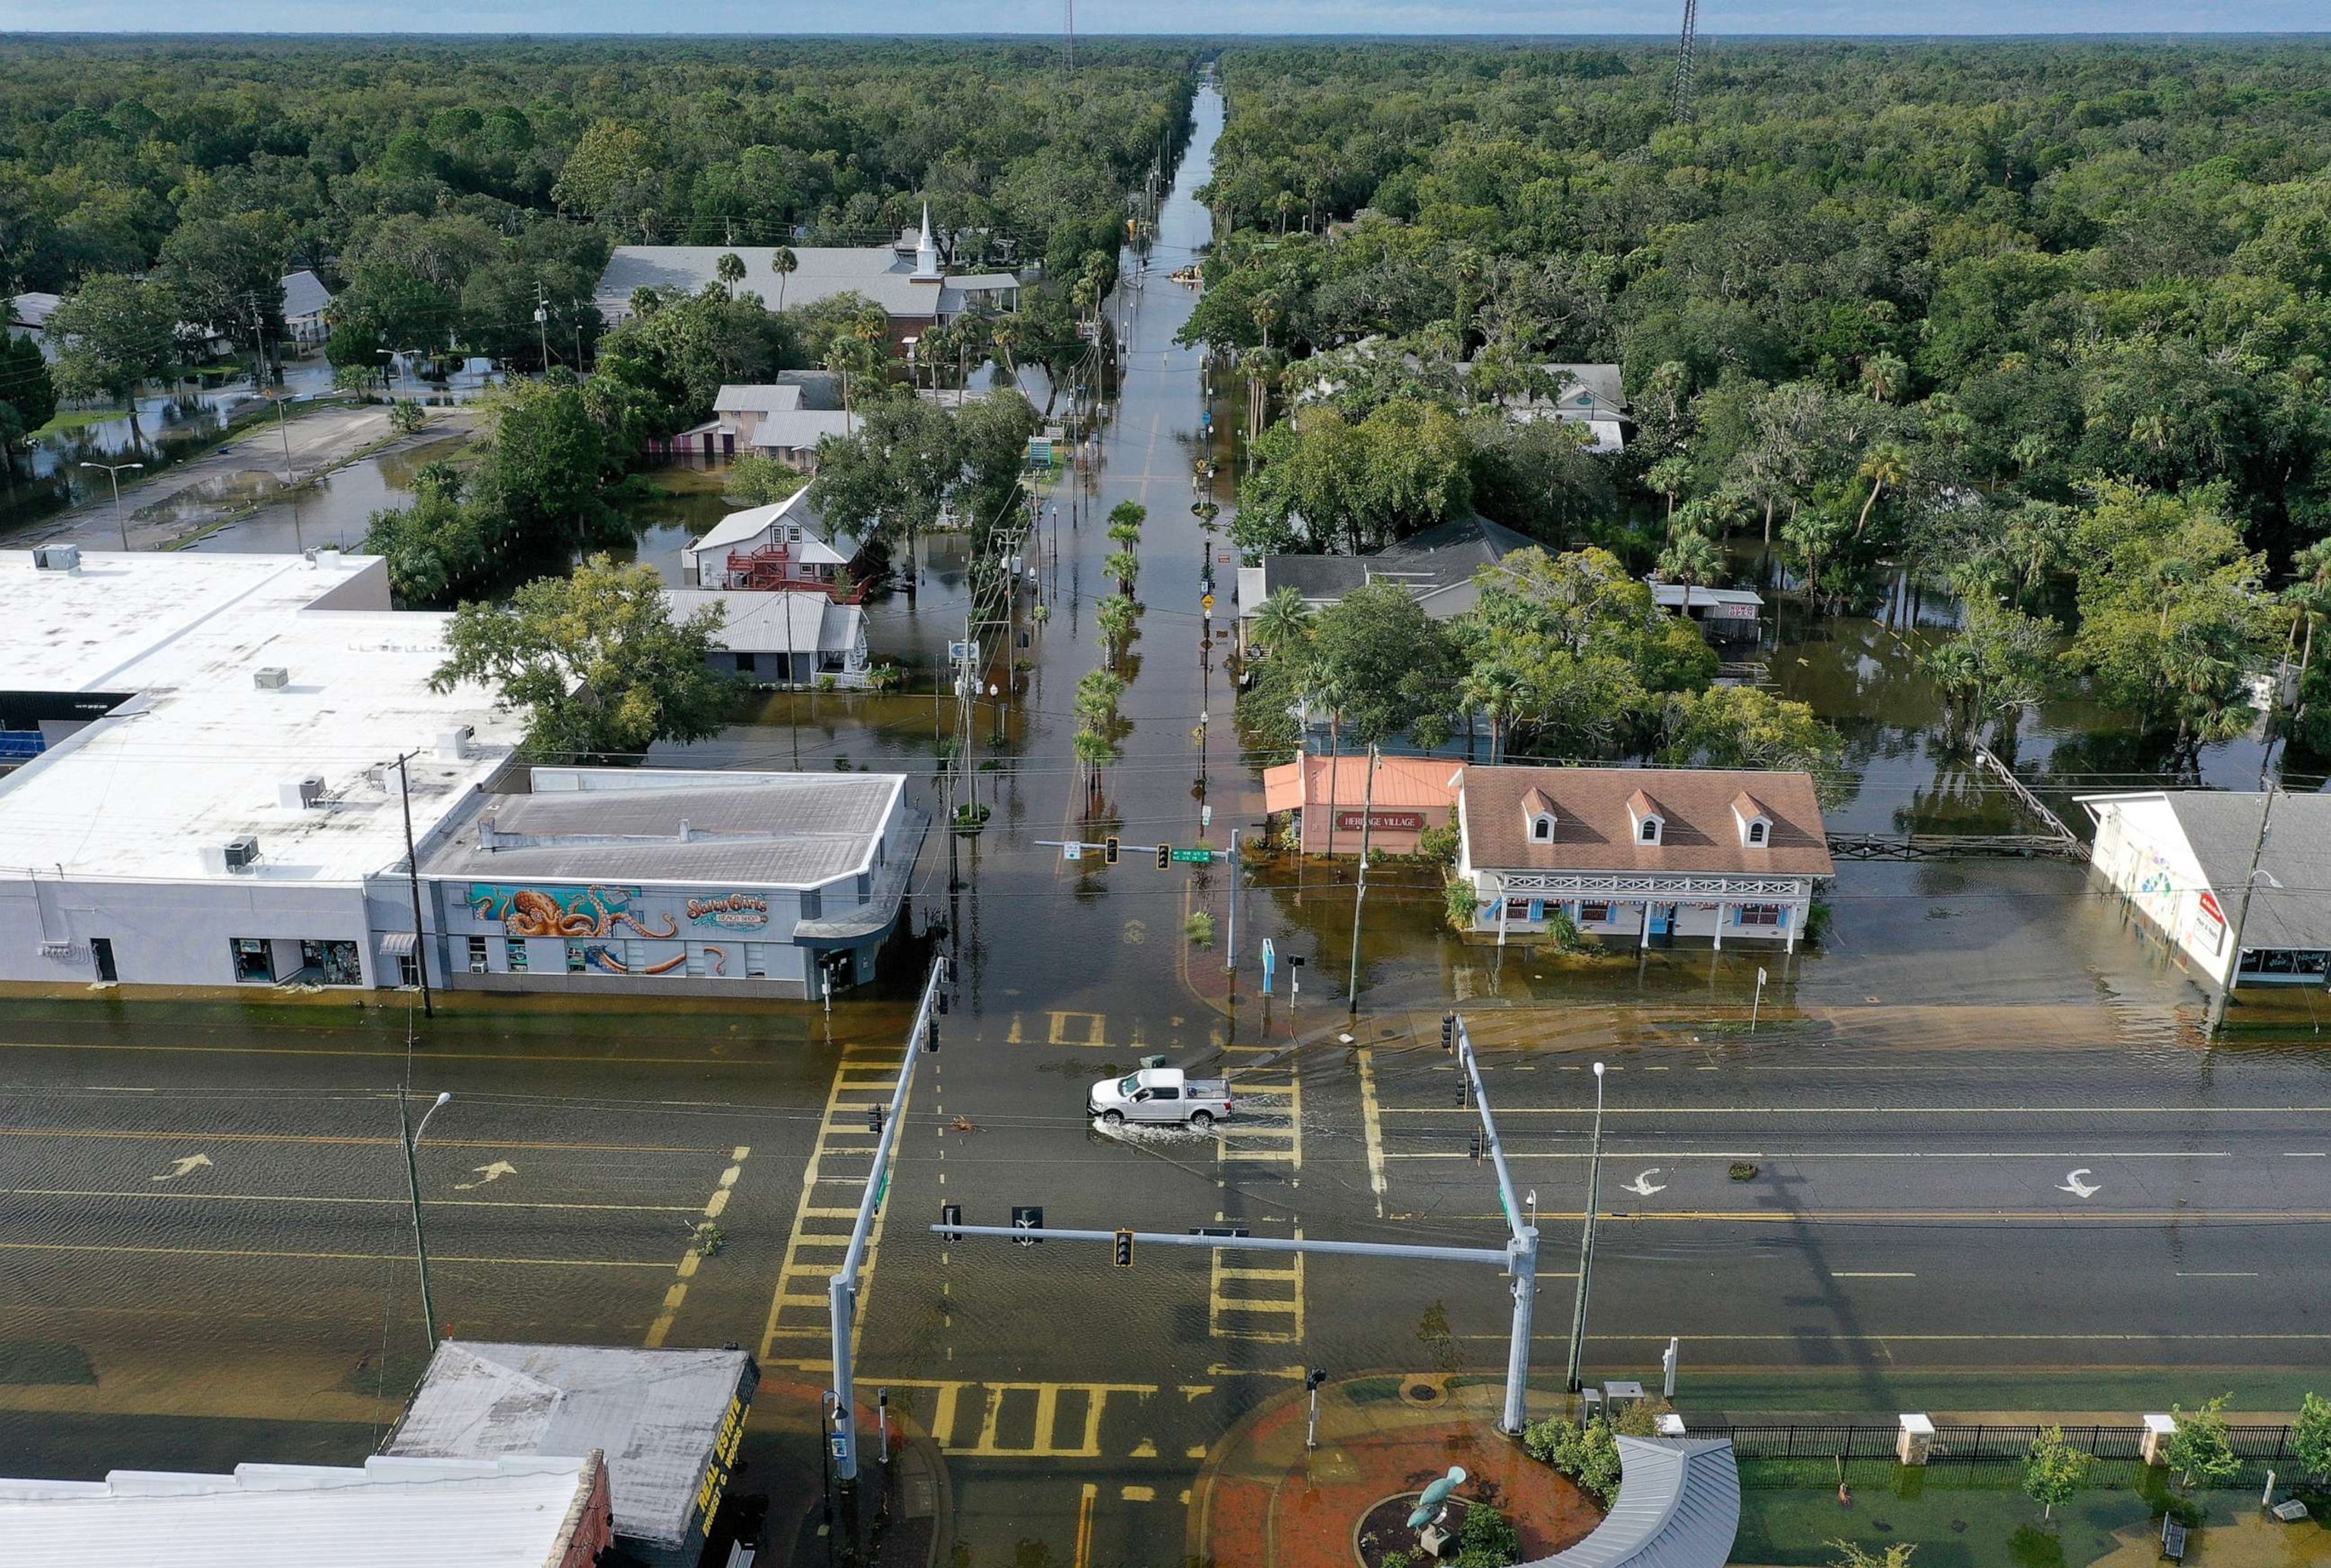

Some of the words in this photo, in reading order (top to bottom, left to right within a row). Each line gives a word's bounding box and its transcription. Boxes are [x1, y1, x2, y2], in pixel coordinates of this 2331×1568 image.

[1345, 818, 1381, 826] HERIAGE
[1384, 818, 1415, 826] VILLAGE
[687, 899, 728, 919] Salty
[728, 894, 767, 912] Girls
[698, 1463, 719, 1513] REAL
[716, 1395, 741, 1460] ESTATE
[703, 1486, 722, 1537] ERNEST
[725, 1426, 743, 1469] WOODS
